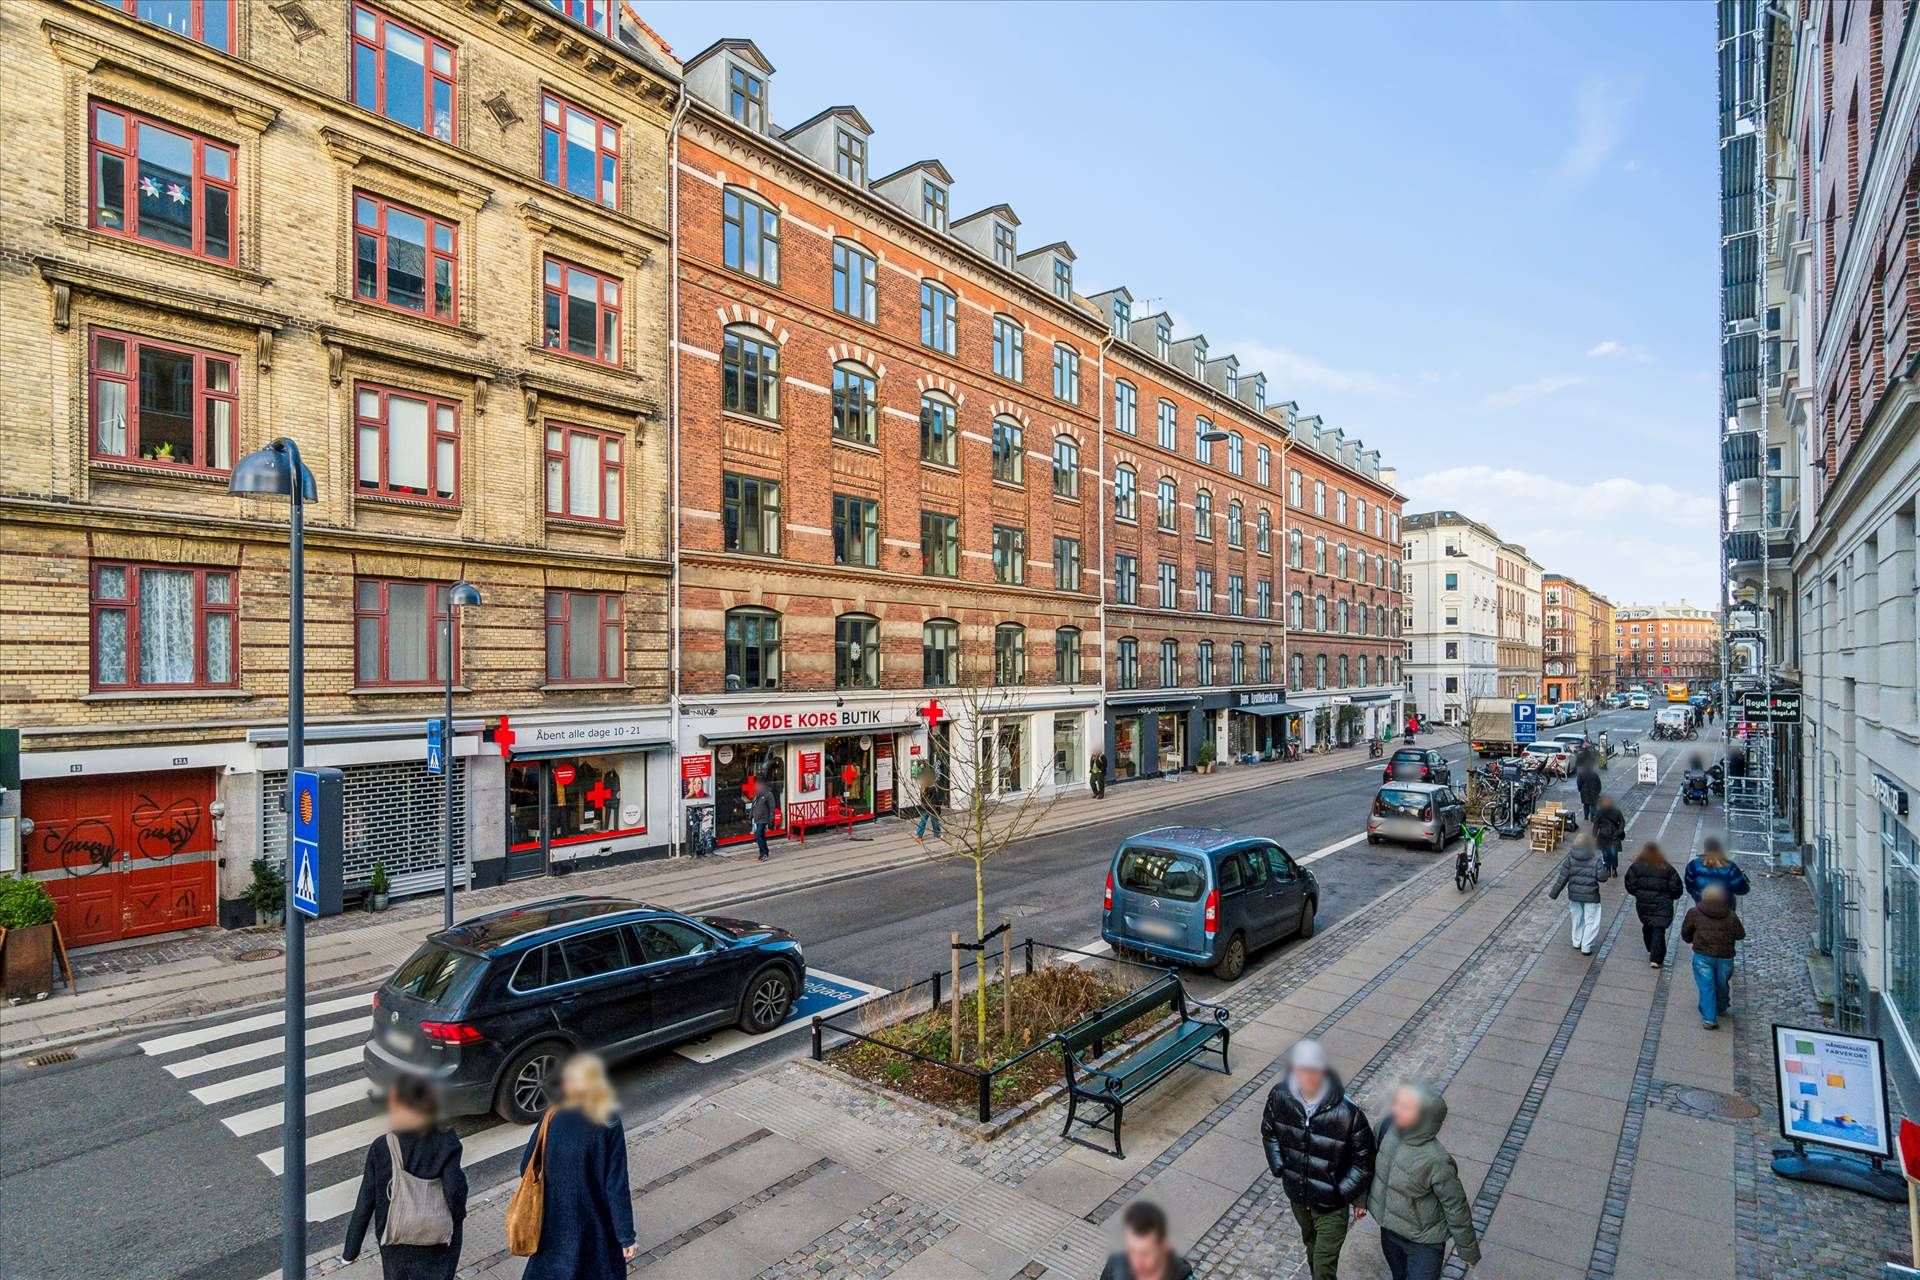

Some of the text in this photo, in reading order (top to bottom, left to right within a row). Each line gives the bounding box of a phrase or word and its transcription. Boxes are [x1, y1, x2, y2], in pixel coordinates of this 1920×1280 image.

[1745, 699, 1799, 709] Royal Bagel
[1519, 705, 1532, 721] P
[747, 710, 881, 731] RØDE KORS BUTIK
[536, 728, 566, 741] Åbent
[568, 730, 585, 739] alle
[588, 728, 611, 739] dage
